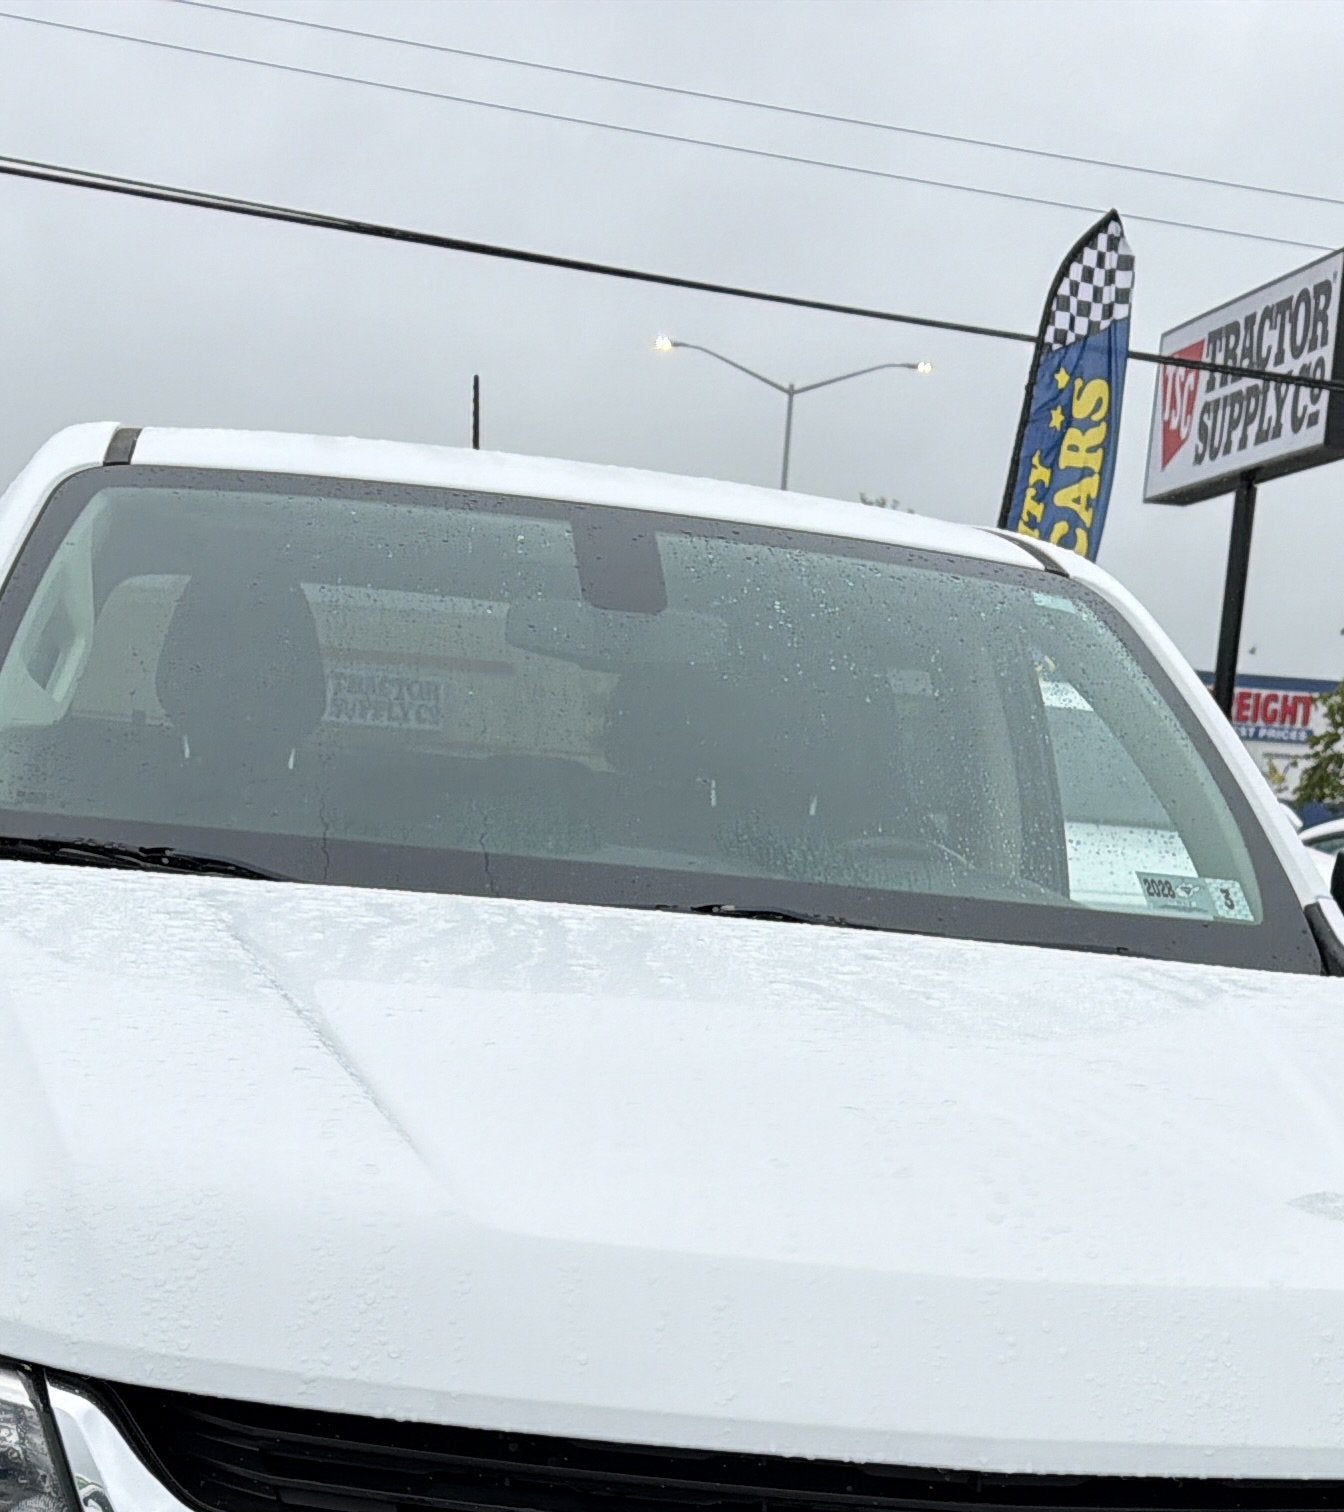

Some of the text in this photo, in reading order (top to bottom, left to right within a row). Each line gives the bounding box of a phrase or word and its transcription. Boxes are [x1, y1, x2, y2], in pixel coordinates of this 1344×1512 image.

[1205, 278, 1333, 394] TRACTOR
[1163, 358, 1197, 441] TSC
[1193, 368, 1293, 466] SUPPLY
[1050, 377, 1110, 558] CARS
